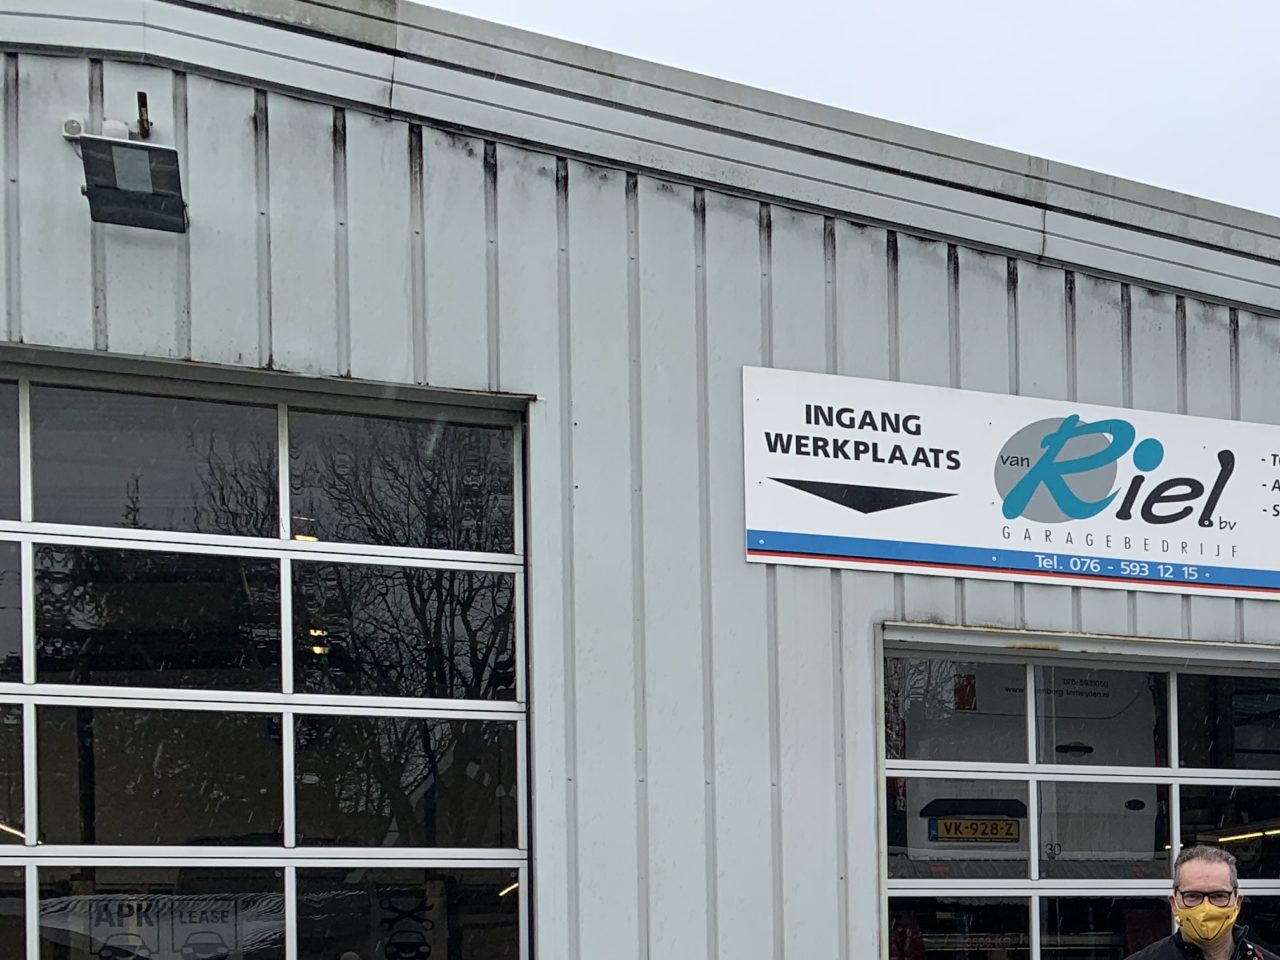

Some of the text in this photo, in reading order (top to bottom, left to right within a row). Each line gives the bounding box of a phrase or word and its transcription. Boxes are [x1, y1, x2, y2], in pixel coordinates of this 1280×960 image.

[804, 403, 922, 436] INGANG
[764, 431, 961, 471] WERKPLAATS
[1000, 413, 1237, 532] van Riel bv
[1002, 525, 1239, 558] GARAGEBEDRIJF
[1034, 554, 1064, 571] Tel.
[1069, 556, 1101, 573] 076
[1120, 560, 1150, 576] 593
[1157, 563, 1174, 578] 12
[1182, 565, 1199, 580] 15
[943, 822, 1014, 836] VK-928-Z
[94, 902, 154, 927] APK
[179, 910, 230, 924] LEASE
